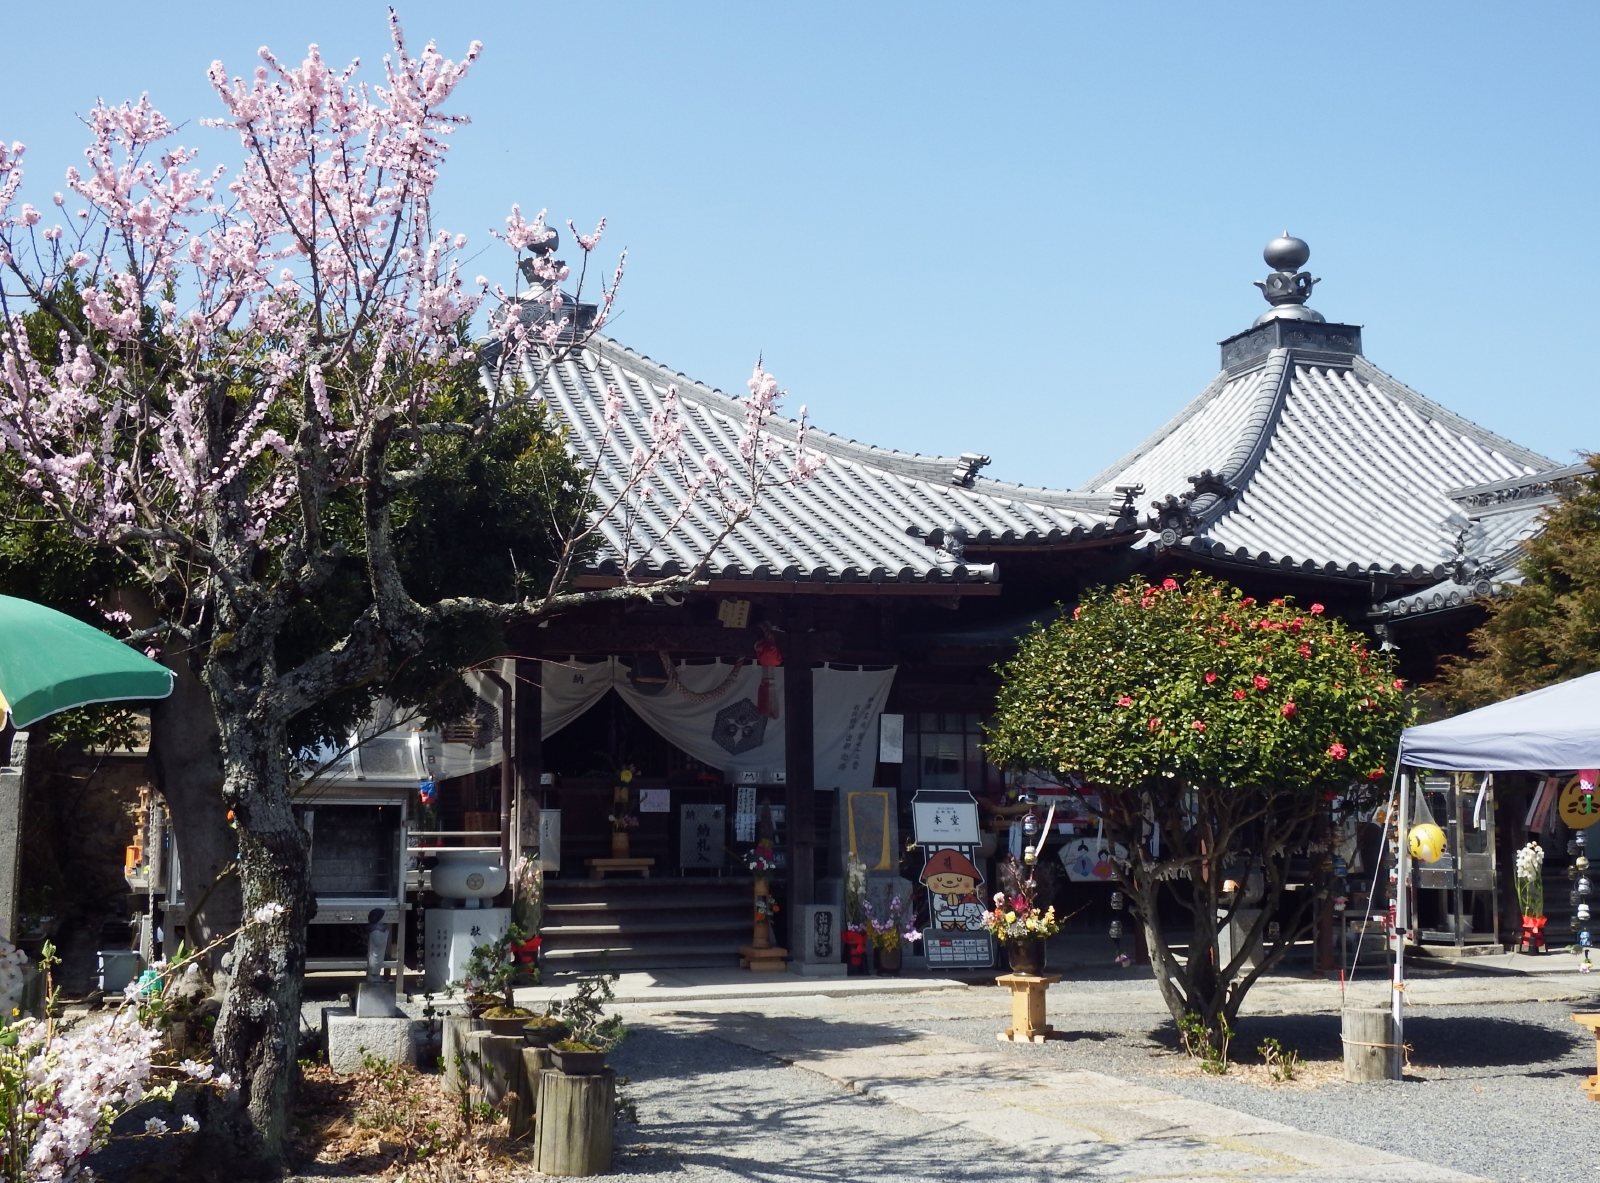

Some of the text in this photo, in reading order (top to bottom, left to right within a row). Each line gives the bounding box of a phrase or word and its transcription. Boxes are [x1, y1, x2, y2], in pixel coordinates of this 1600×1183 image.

[934, 814, 960, 826] 本堂
[696, 823, 711, 863] 納札入
